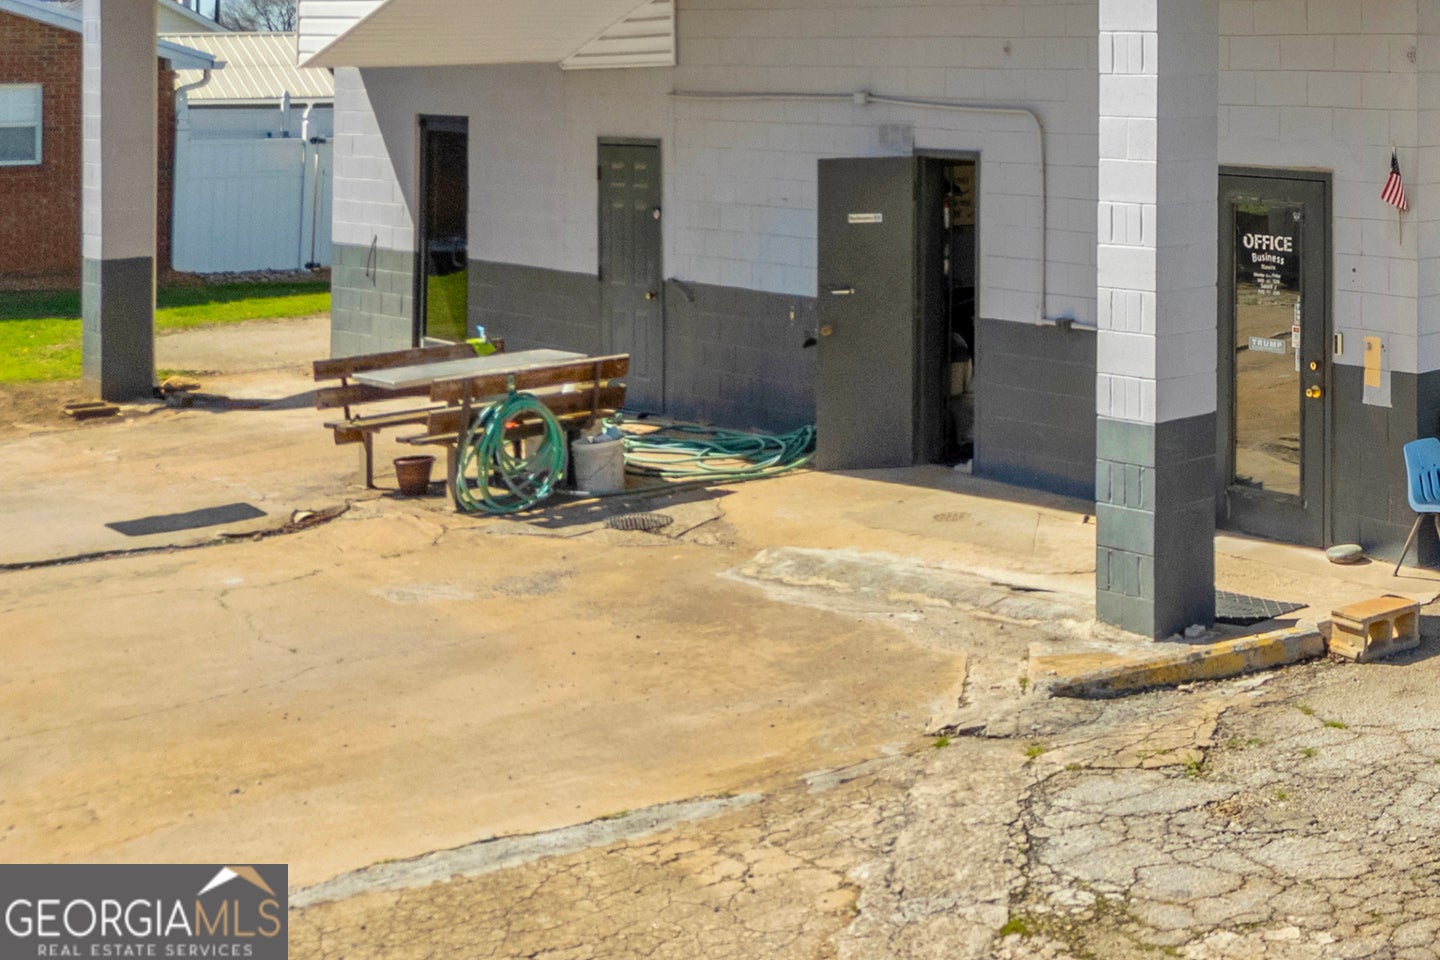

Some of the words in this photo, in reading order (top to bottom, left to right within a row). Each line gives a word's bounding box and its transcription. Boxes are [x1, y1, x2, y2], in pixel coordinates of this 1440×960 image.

[1242, 233, 1293, 253] OFFICE
[1251, 252, 1285, 265] Business
[1251, 339, 1283, 348] TRUMP
